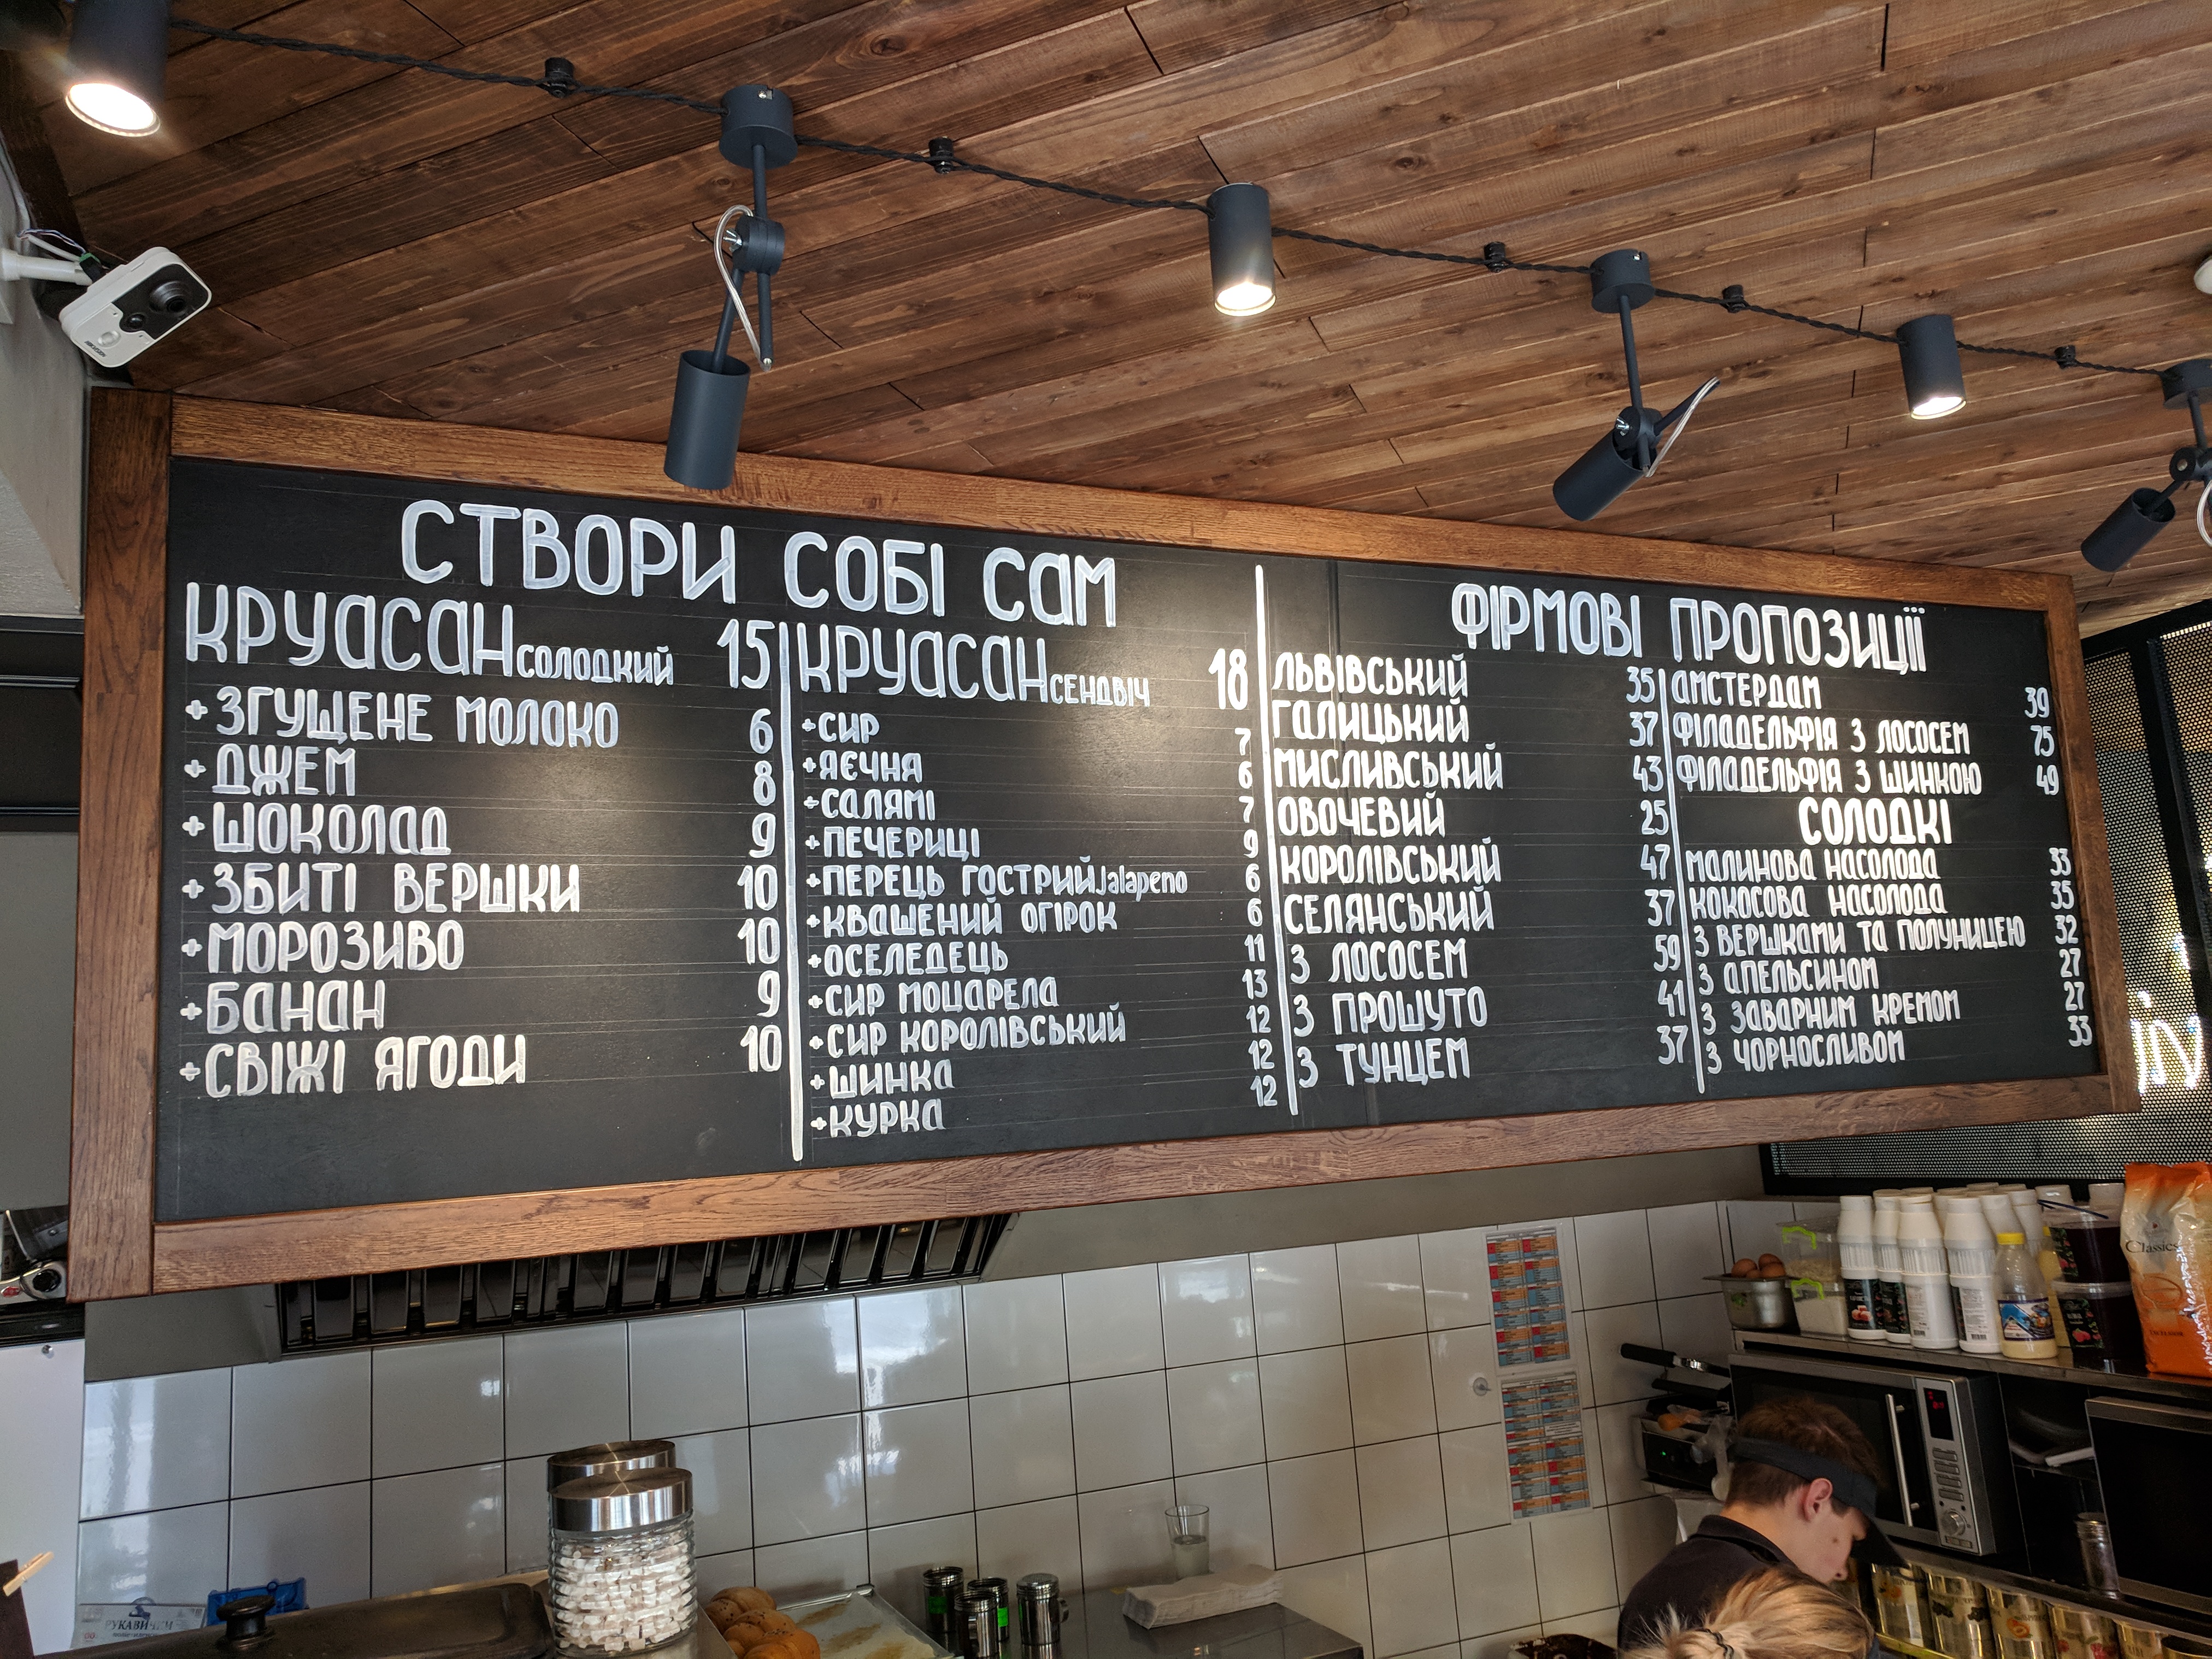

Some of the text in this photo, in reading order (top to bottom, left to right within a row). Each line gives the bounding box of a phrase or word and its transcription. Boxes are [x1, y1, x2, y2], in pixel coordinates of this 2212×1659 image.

[402, 500, 1116, 627] СТВОРИ СОБІ САМ
[186, 582, 513, 676] КРУАСАН
[717, 619, 775, 689] 15
[1452, 583, 1926, 675] ФІРМОВІ ПРОПОЗИЦІЇ
[797, 622, 1048, 703] КРУАСАН
[1208, 648, 1248, 710] 18
[1270, 652, 1655, 703] ЛЬВІВСЬКИЙ 35
[1672, 670, 2049, 717] АМСТЕРДАМ 39
[217, 686, 433, 744] ЗГУЩЕНЕ
[456, 696, 618, 748] МОЛОКО
[750, 708, 773, 754] 6
[819, 712, 879, 744] СИР
[1235, 728, 1251, 756] 7
[1271, 697, 1658, 747] ГАЛИЦЬКИЙ 37
[1673, 712, 1838, 752] ФІЛАДЕЛЬФІЯ
[1875, 720, 1970, 754] ЛОСОСЕМ
[2031, 725, 2054, 756] 75
[212, 743, 356, 796] ДЖЕМ
[754, 760, 776, 806] 8
[1239, 761, 1252, 789] 6
[1274, 743, 1663, 792] МИСЛИВСЬКИЙ 43
[1676, 755, 1843, 793] ФІЛАДЕЛЬФІЯ
[1879, 760, 1981, 795] ШИНКОЮ
[2037, 765, 2058, 795] 49
[213, 802, 451, 855] ШОКОЛАД
[749, 813, 775, 858] 9
[821, 789, 935, 821] САЛЯМІ
[1239, 796, 1254, 823] 7
[1278, 791, 1669, 838] ОВОЧЕВИЙ 25
[1798, 797, 1952, 845] СОЛОДКІ
[824, 826, 979, 861] ПЕЧЕРИЦІ
[1244, 829, 1258, 858] 9
[1280, 837, 1670, 885] КОРОЛІВСЬКИЙ 47
[1686, 848, 2071, 883] МАЛИНОВА НАСОЛОДА 33
[212, 862, 356, 915] ЗБИТІ
[395, 863, 579, 913] ВЕРШКИ
[737, 864, 778, 910] 10
[823, 864, 945, 900] ПЕРЕЦЬ
[962, 855, 1095, 897] ГОСТРИЙ
[1246, 863, 1260, 892] 6
[1689, 880, 2074, 920] КОКОСОВА НАСОЛОДА 35
[823, 897, 1002, 938] КВАШЕНИЙ
[1021, 901, 1117, 934] ОГІРОК
[1248, 898, 1262, 927] 6
[1284, 885, 1675, 934] СЕЛЯНСЬКИЙ 37
[208, 920, 464, 974] МОРОЗИВО
[738, 917, 780, 964] 10
[825, 942, 1008, 977] ОСЕЛЕДЕЦЬ
[1244, 934, 1265, 961] 11
[1328, 938, 1467, 983] ЛОСОСЕМ
[1654, 934, 1680, 972] 59
[1716, 922, 1846, 956] ВЕРШКАМИ
[1856, 920, 1889, 952] ТА
[1897, 916, 2026, 951] ПОЛУНИЦЕЮ
[2055, 915, 2078, 944] 32
[826, 983, 885, 1017] СИР
[899, 976, 1059, 1014] МОЦАРЕЛА
[1242, 969, 1267, 999] 13
[1724, 957, 1879, 995] АПЕЛЬСИНОМ
[2060, 948, 2080, 977] 27
[207, 980, 385, 1034] БАНАН
[757, 970, 780, 1017] 9
[1332, 986, 1487, 1035] ПРОШУТО
[1658, 980, 1685, 1017] 41
[1731, 996, 1856, 1033] ЗАВАРНИМ
[1872, 990, 1960, 1026] КРЕМОМ
[2064, 981, 2084, 1010] 27
[827, 1022, 886, 1058] СИР
[901, 1002, 1125, 1055] КОРОЛІВСЬКИЙ
[1246, 1005, 1271, 1033] 12
[1734, 1030, 1905, 1072] ЧОРНОСЛИВОМ
[2068, 1016, 2092, 1046] 33
[205, 1040, 345, 1098] СВІЖІ
[375, 1034, 526, 1091] ЯГОДИ
[740, 1025, 782, 1072] 10
[829, 1059, 955, 1099] ШИНКА
[1249, 1039, 1274, 1069] 12
[1336, 1038, 1469, 1086] ТУНЦЕМ
[1657, 1025, 1688, 1064] 37
[830, 1099, 945, 1137] КУРКА
[1250, 1075, 1277, 1107] 12
[2125, 1240, 2179, 1253] Classics
